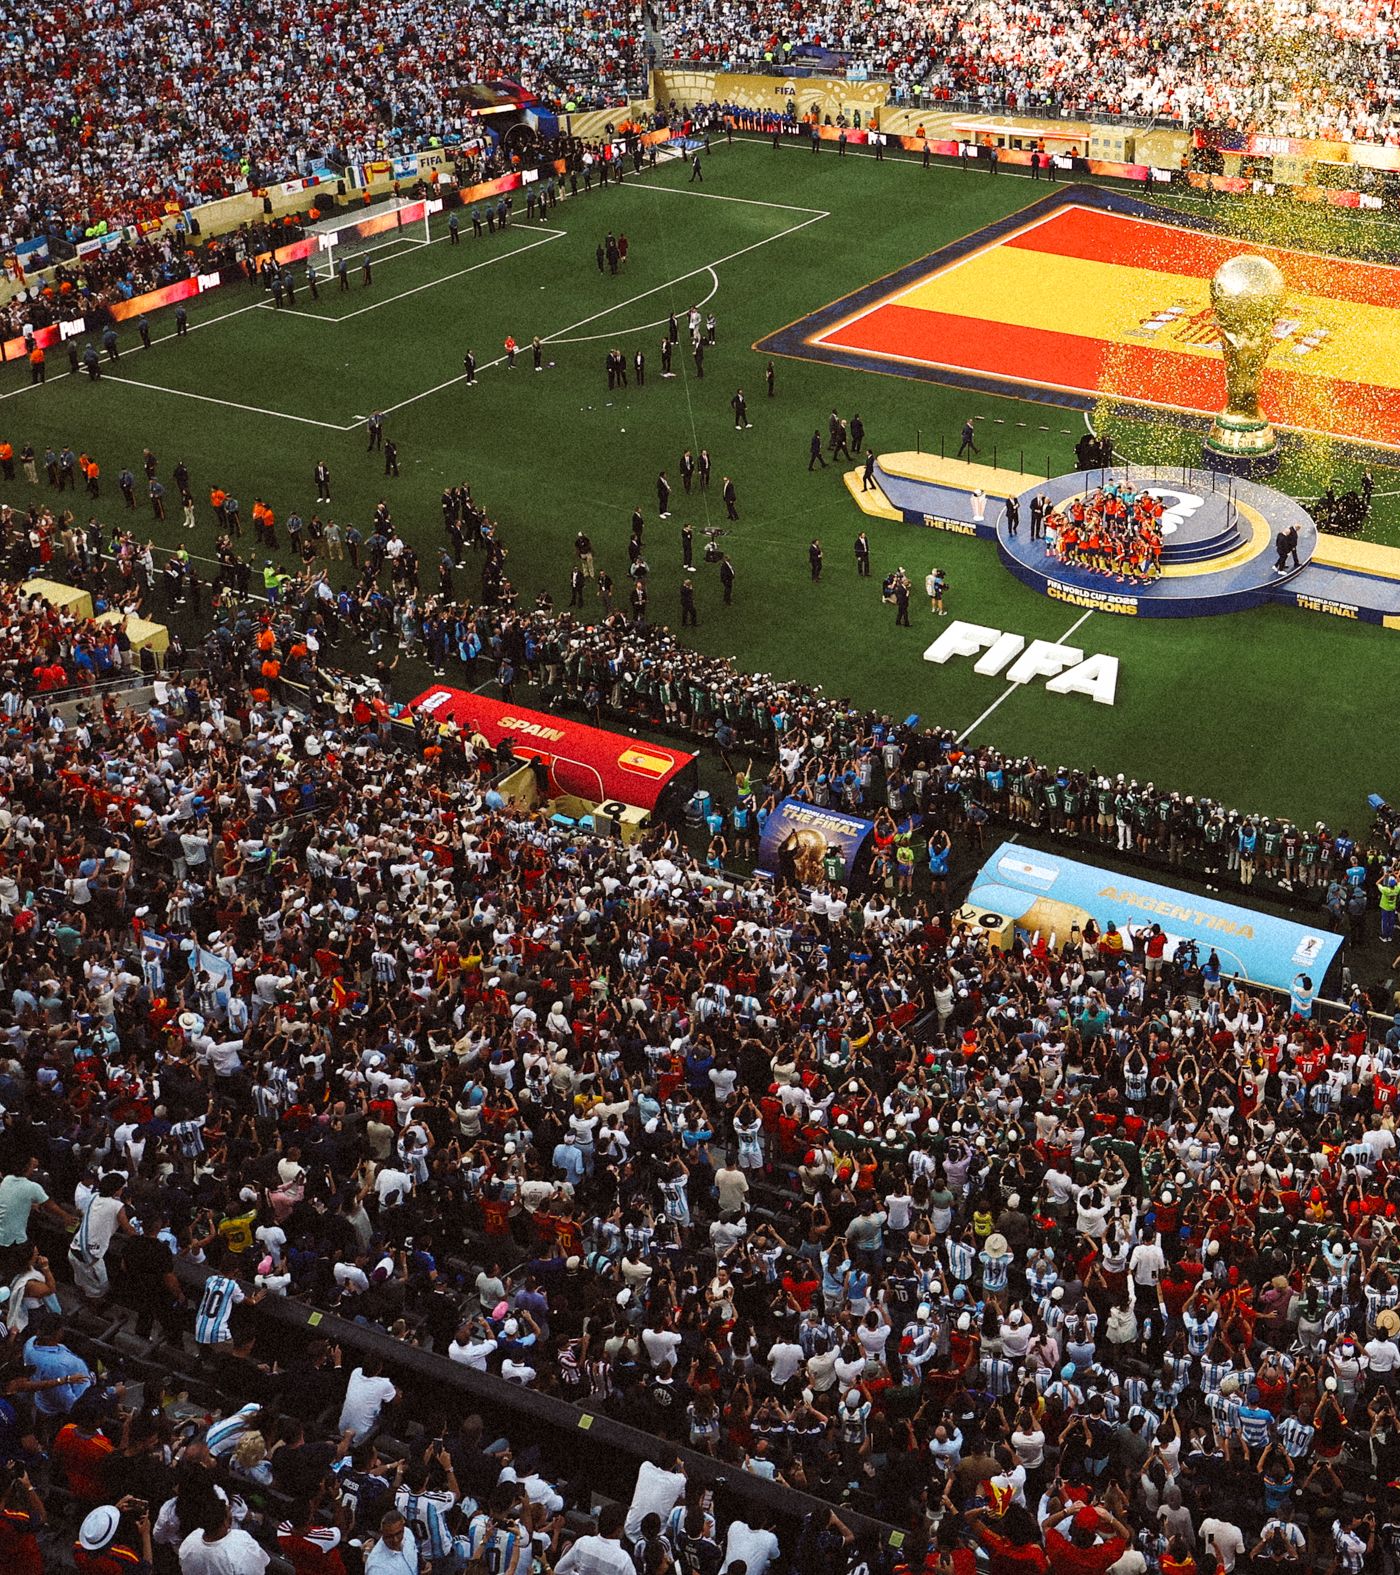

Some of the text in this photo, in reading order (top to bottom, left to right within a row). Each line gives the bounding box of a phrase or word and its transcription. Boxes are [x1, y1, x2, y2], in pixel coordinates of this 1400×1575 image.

[775, 86, 796, 96] FIFA
[421, 155, 442, 168] FIFA
[924, 519, 977, 536] THE FINAL
[1047, 579, 1138, 605] FIFA WORLD CUP 2026
[1047, 587, 1138, 615] CHAMPIONS
[1297, 598, 1359, 619] THE FINAL
[923, 620, 1120, 706] FIFA
[497, 716, 565, 742] SPAIN
[782, 808, 858, 837] THE FINAL
[785, 803, 865, 830] FIFA WORLD CUP 2026
[1098, 886, 1255, 940] ARGENTINA
[1303, 1064, 1312, 1073] 10
[1318, 1093, 1328, 1104] 10
[1378, 1091, 1389, 1101] 10
[1356, 1153, 1368, 1164] 10
[201, 1290, 223, 1318] 10
[1289, 1427, 1307, 1446] 10
